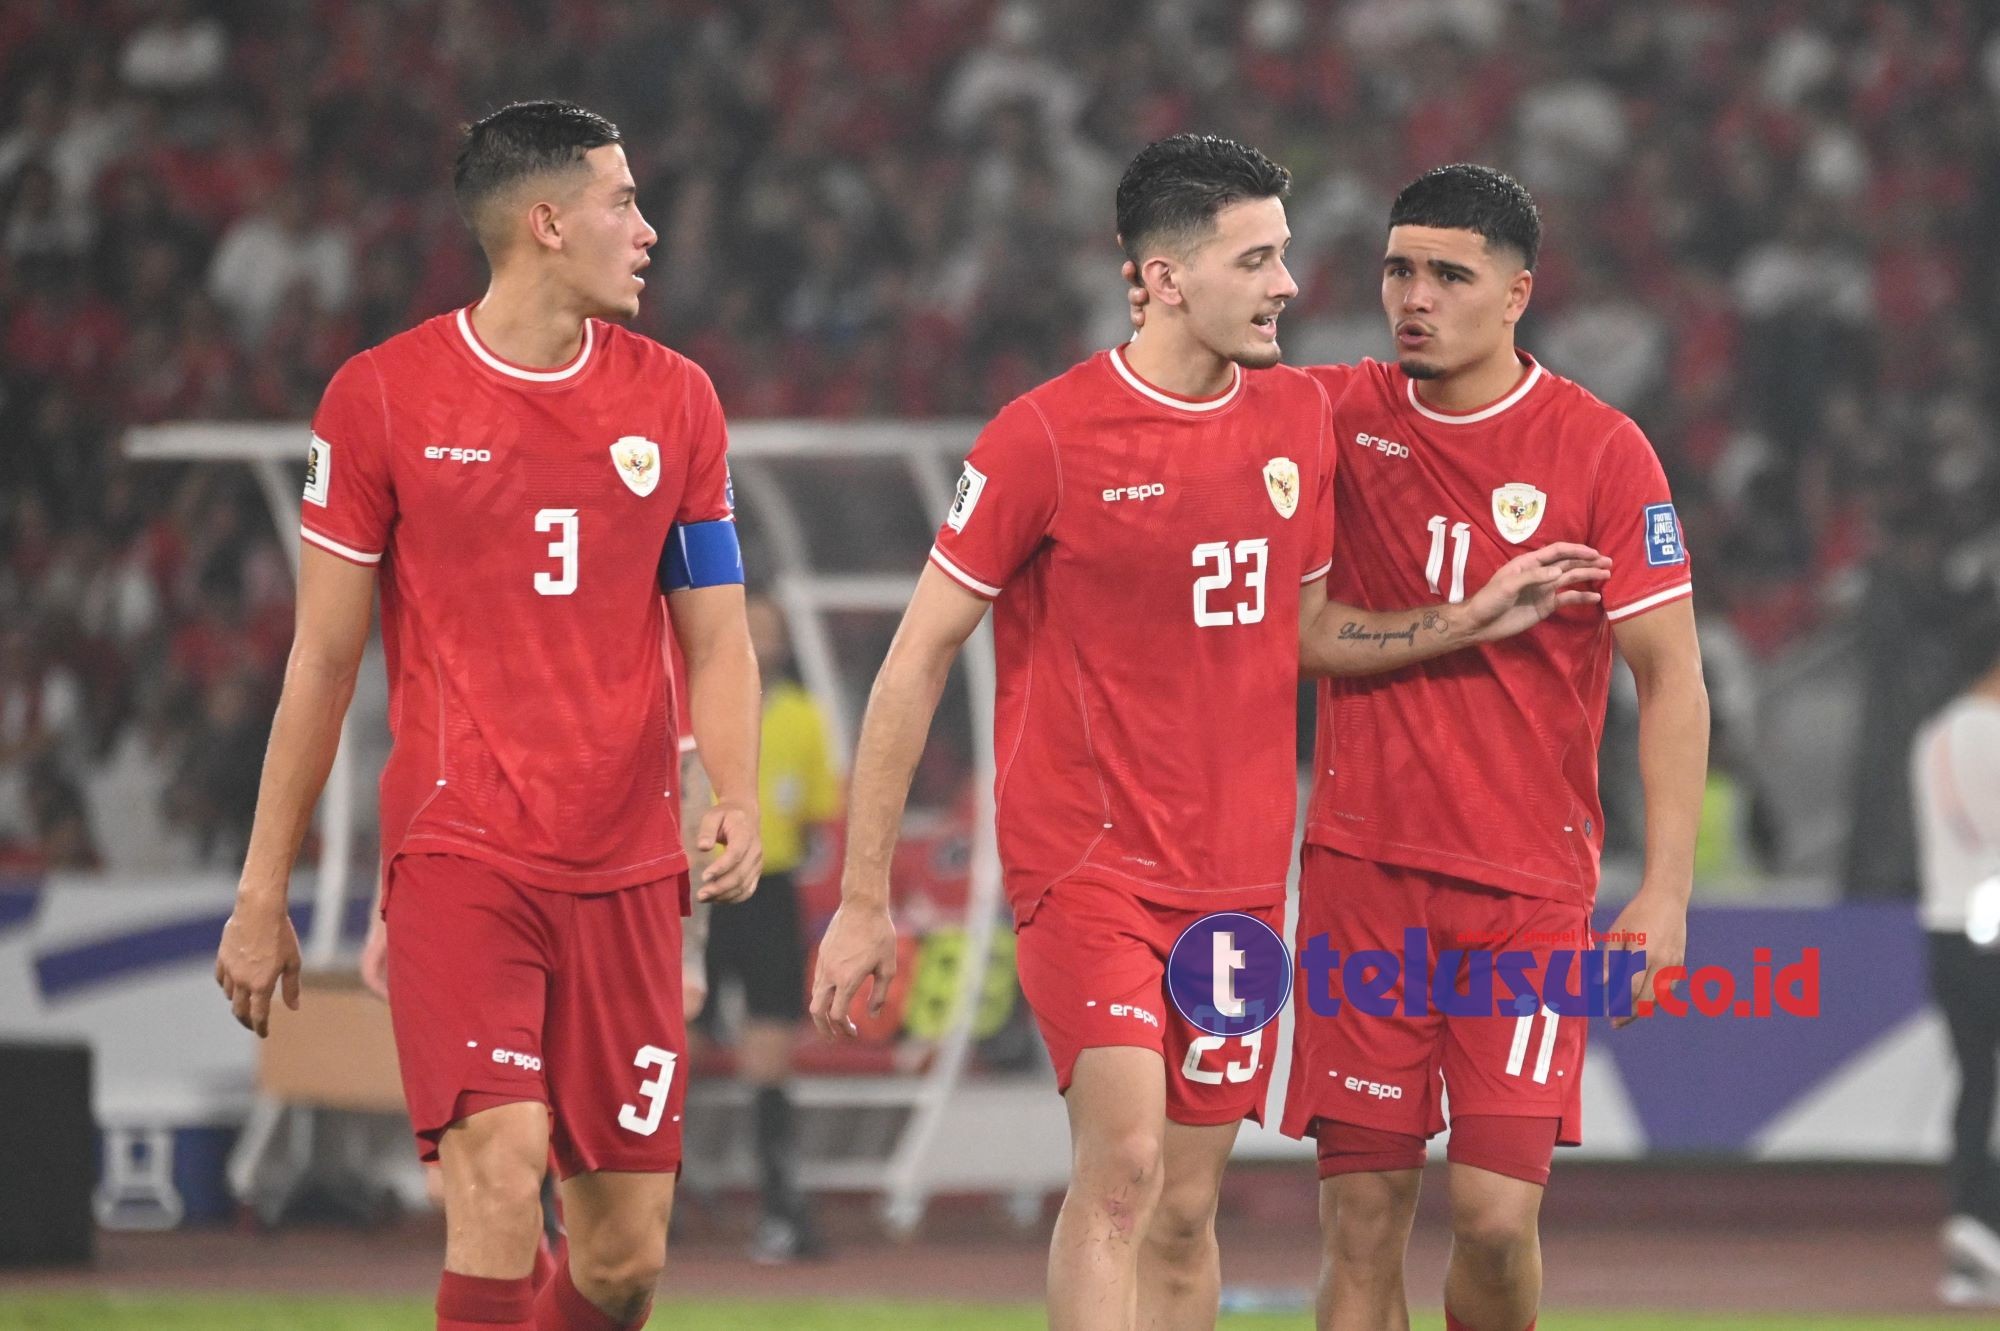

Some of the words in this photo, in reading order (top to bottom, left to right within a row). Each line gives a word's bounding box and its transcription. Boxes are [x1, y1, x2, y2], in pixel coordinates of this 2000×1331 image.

[424, 446, 492, 465] erspo
[1356, 432, 1410, 459] erspo
[1102, 482, 1165, 503] erspo
[533, 508, 579, 597] 3
[1425, 514, 1471, 604] 11
[1191, 537, 1269, 628] 23
[1109, 1003, 1159, 1028] erspo
[1181, 998, 1266, 1085] 23
[1504, 994, 1561, 1085] 11
[491, 1048, 542, 1071] erspo
[617, 1044, 678, 1137] 3
[1344, 1076, 1402, 1101] erspo
